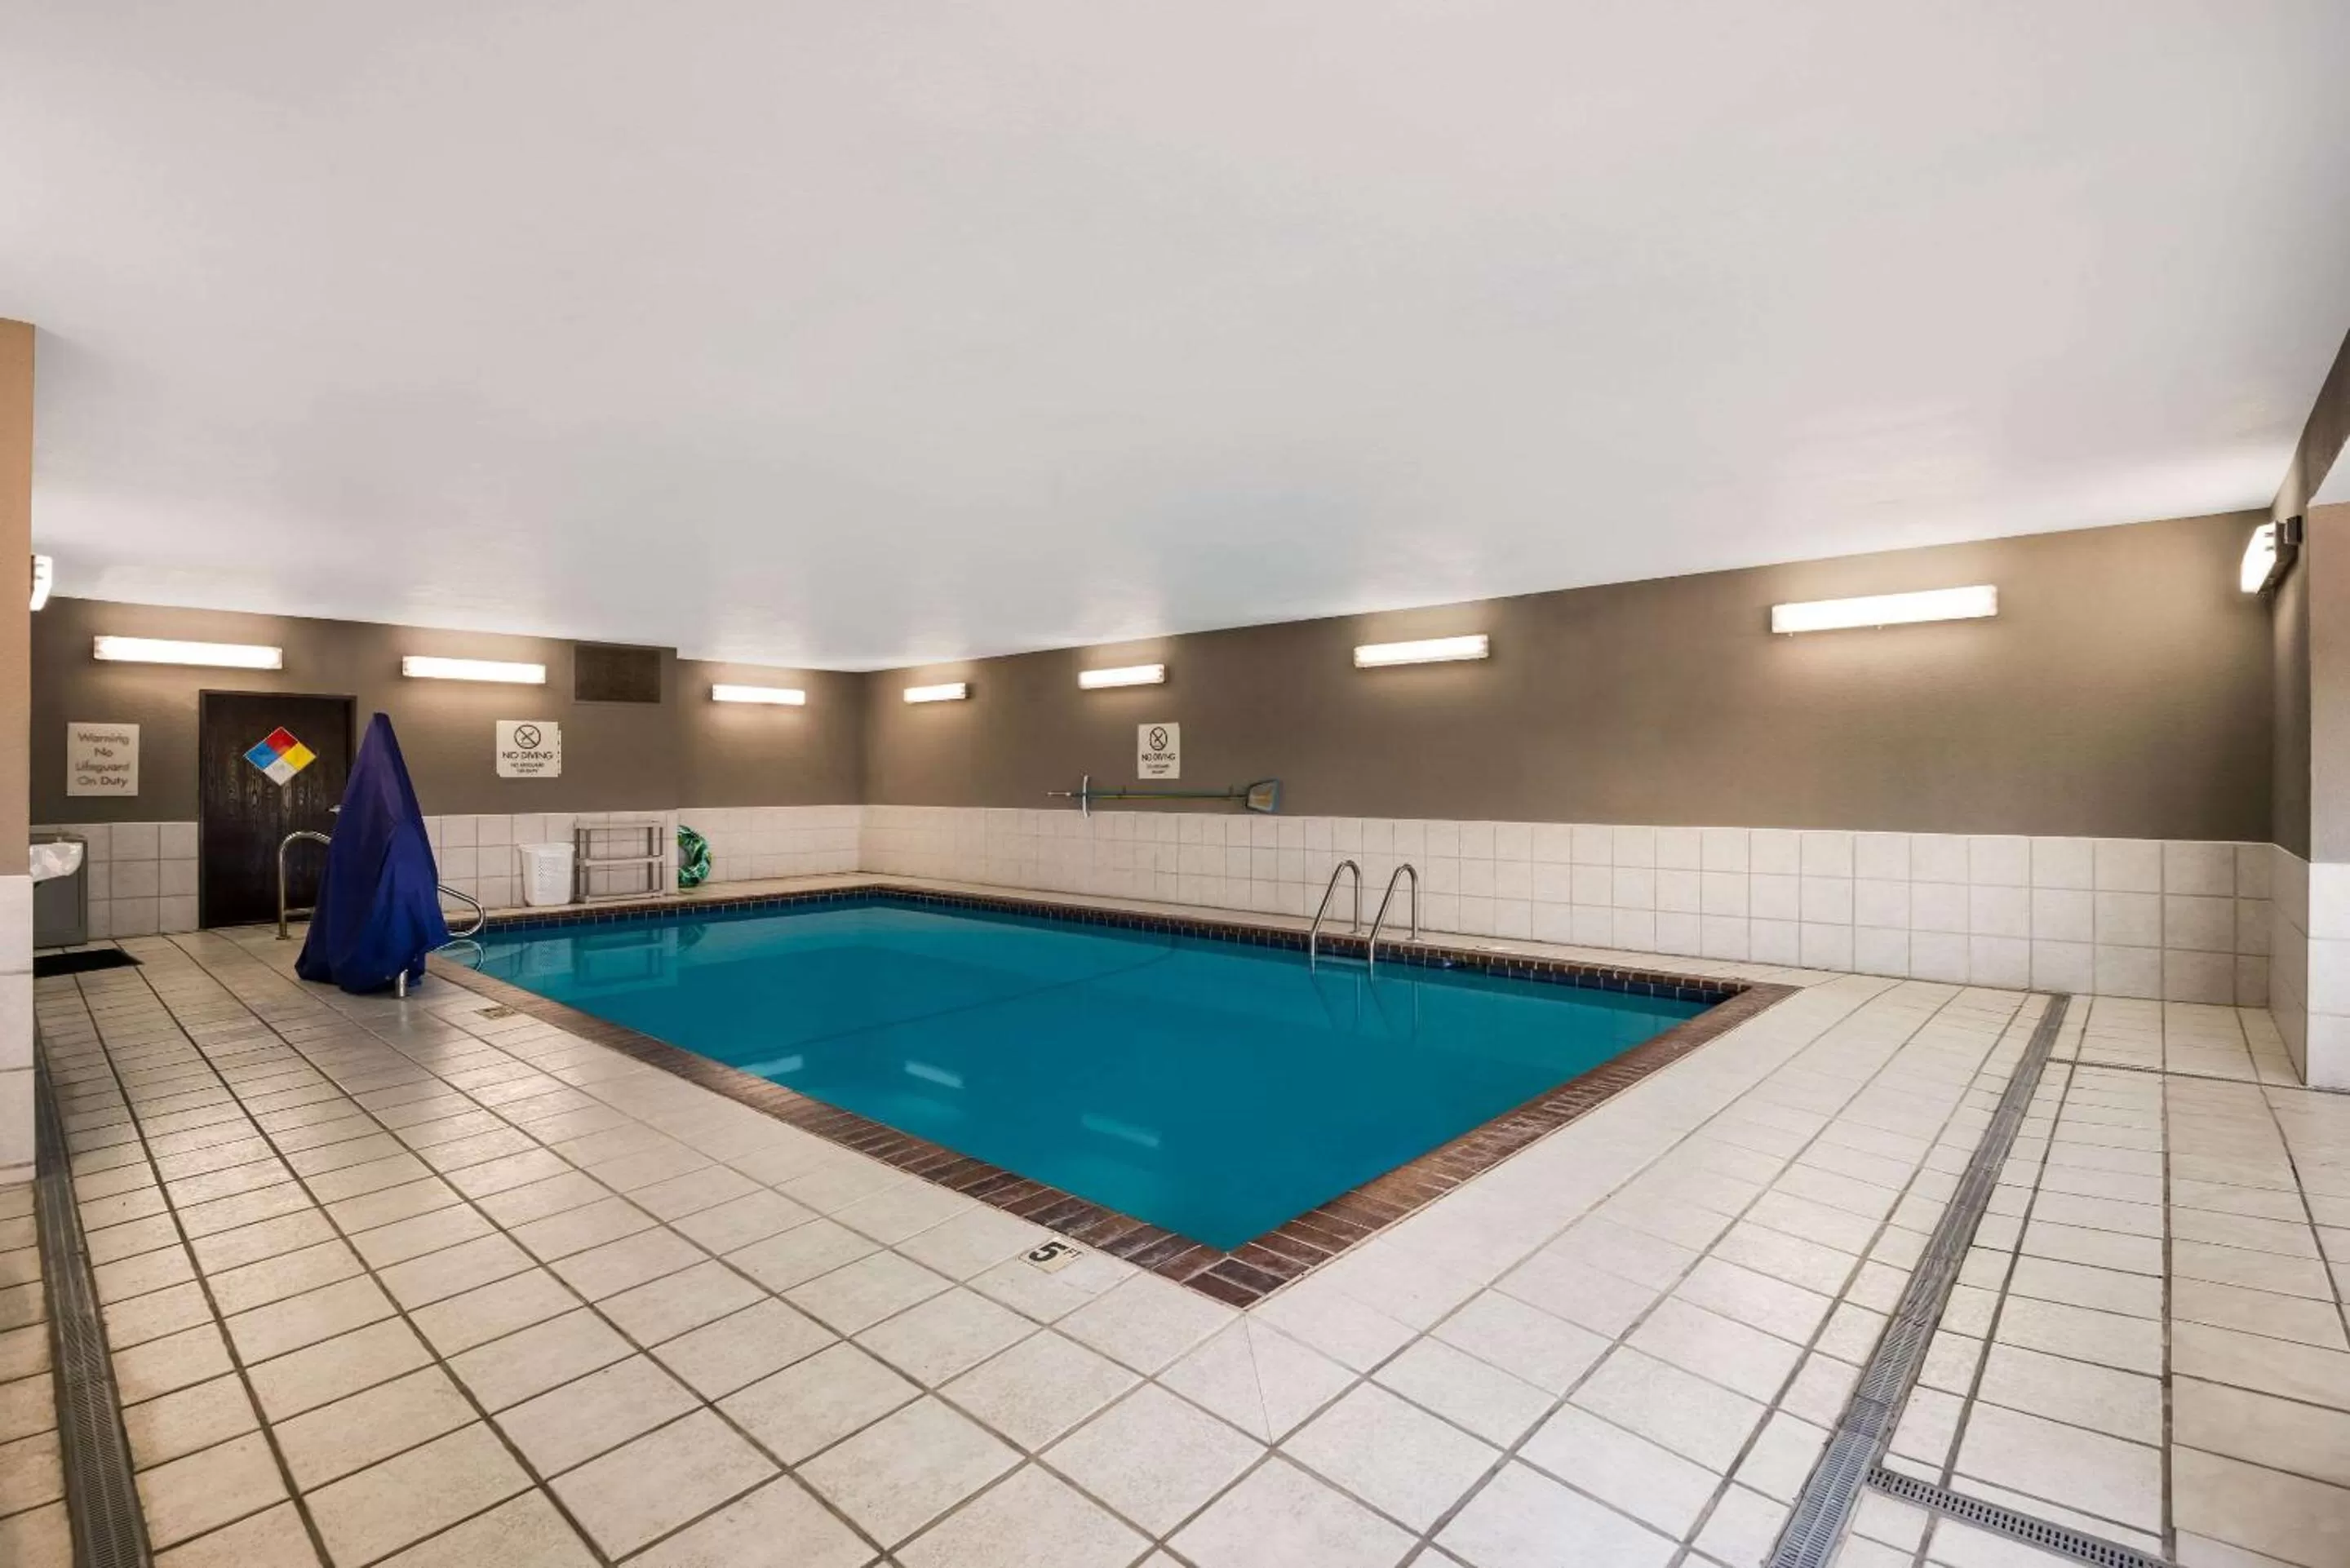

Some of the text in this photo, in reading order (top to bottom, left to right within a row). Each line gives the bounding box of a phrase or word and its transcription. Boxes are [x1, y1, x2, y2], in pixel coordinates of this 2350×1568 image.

[94, 747, 113, 757] No
[521, 751, 553, 760] DIVING
[76, 775, 128, 788] On Duty
[1029, 1242, 1069, 1261] 5
